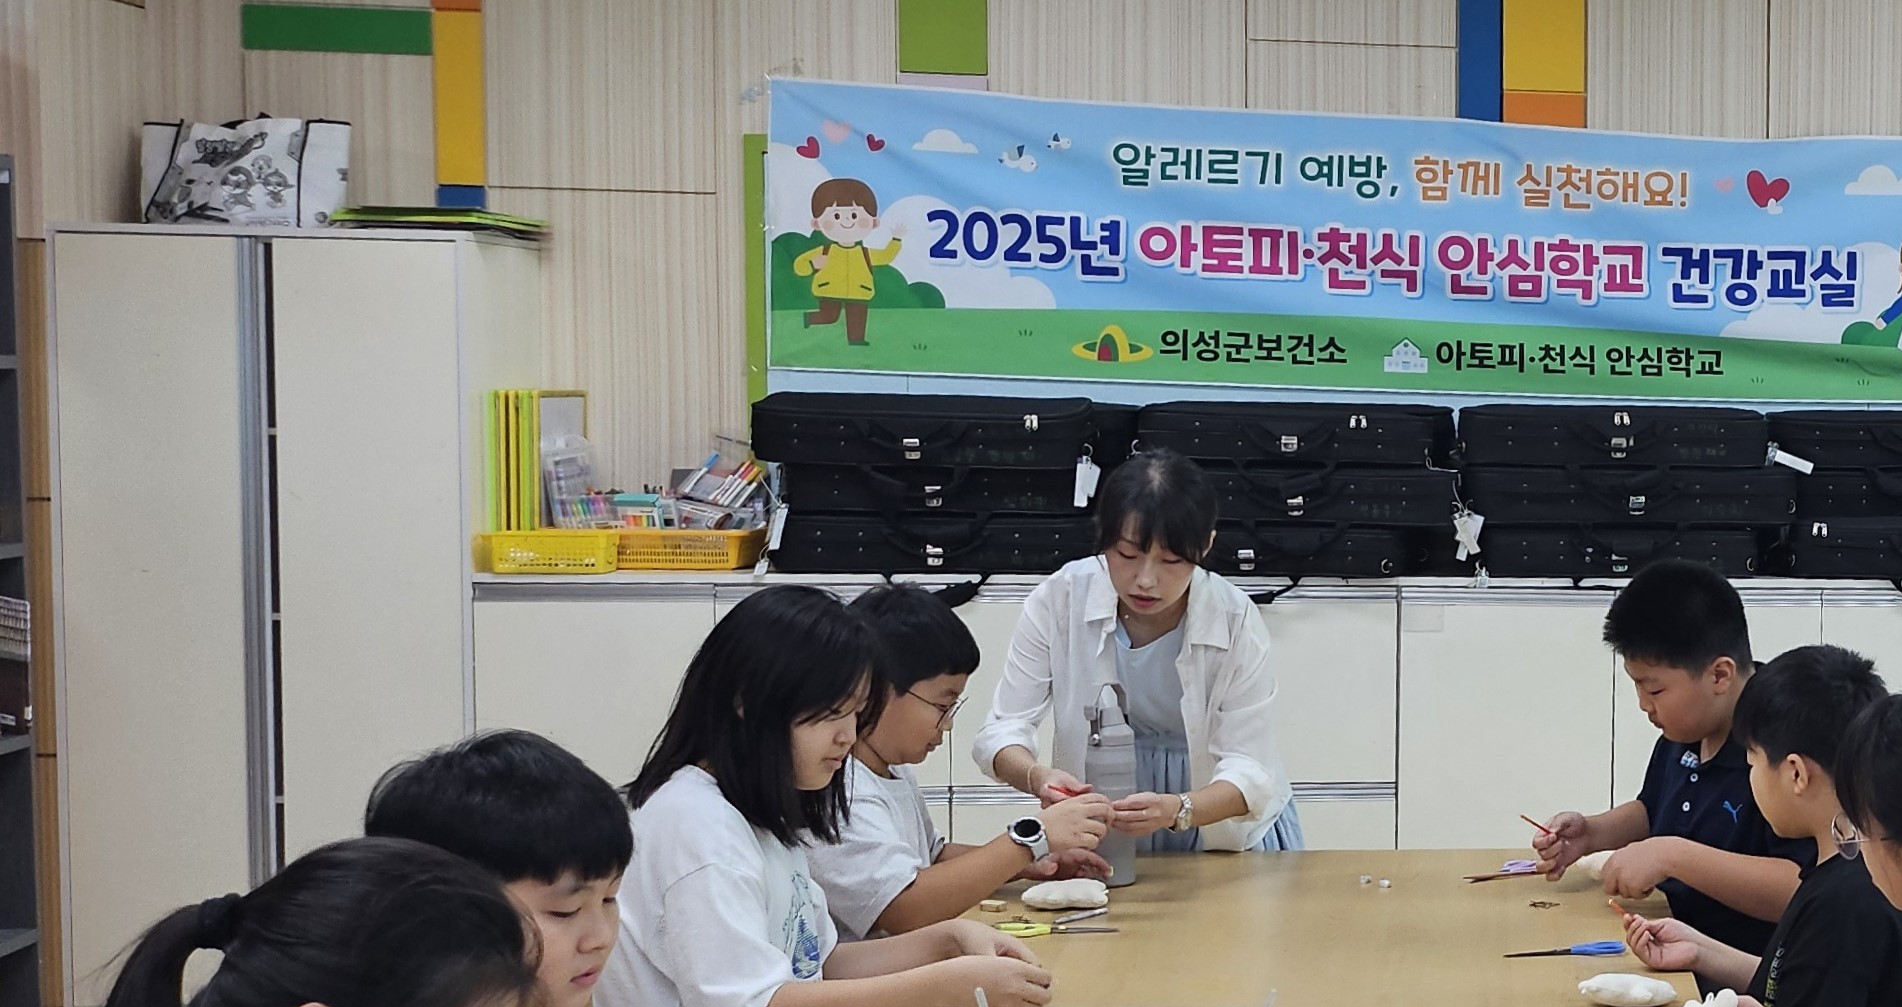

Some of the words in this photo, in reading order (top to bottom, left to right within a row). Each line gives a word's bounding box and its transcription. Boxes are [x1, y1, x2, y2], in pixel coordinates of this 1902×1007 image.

[1112, 143, 1282, 186] 알레르기
[1300, 154, 1398, 199] 예방,
[1414, 155, 1501, 201] 함께
[1516, 163, 1688, 209] 실천해요!
[927, 209, 1121, 277] 2025년
[1139, 224, 1421, 293] 아토피·천식
[1437, 235, 1645, 300] 안심학교
[1661, 246, 1858, 308] 건강교실
[1159, 328, 1348, 366] 의성군보건소
[1435, 340, 1596, 376] 아토피·천식
[1604, 346, 1725, 378] 안심학교
